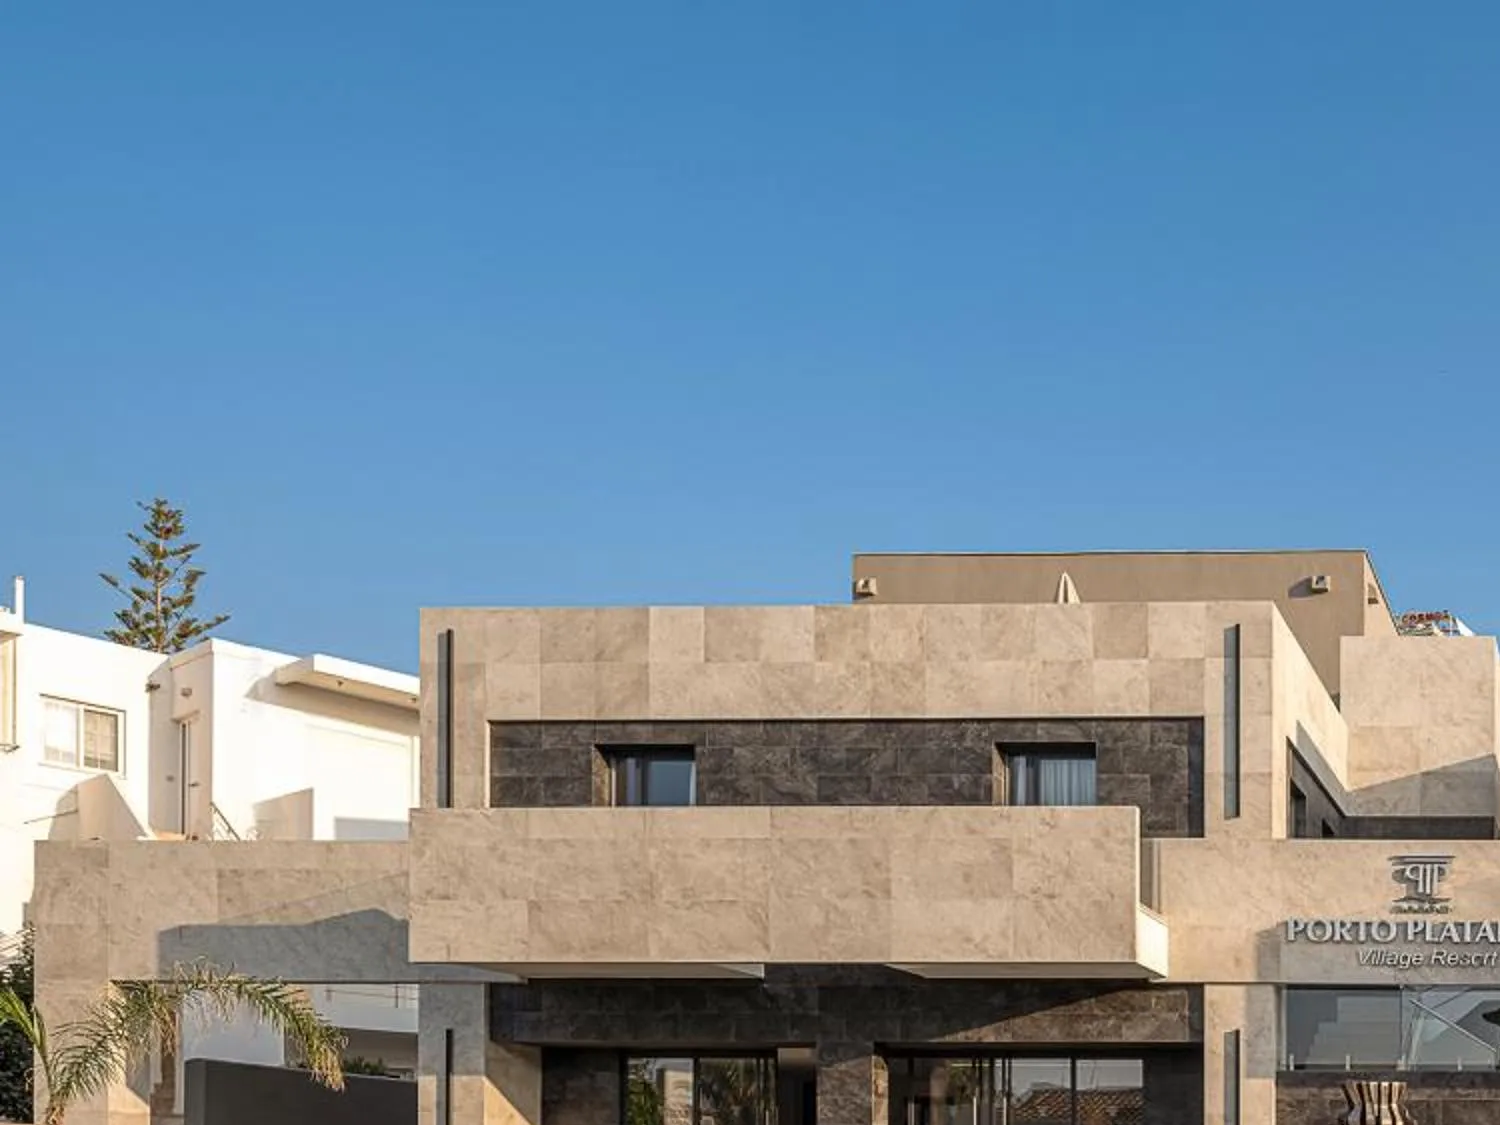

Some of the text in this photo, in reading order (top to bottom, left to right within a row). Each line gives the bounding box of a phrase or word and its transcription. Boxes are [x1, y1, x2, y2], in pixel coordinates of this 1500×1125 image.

[1286, 917, 1397, 943] PORTO
[1358, 947, 1498, 969] Village Resort
